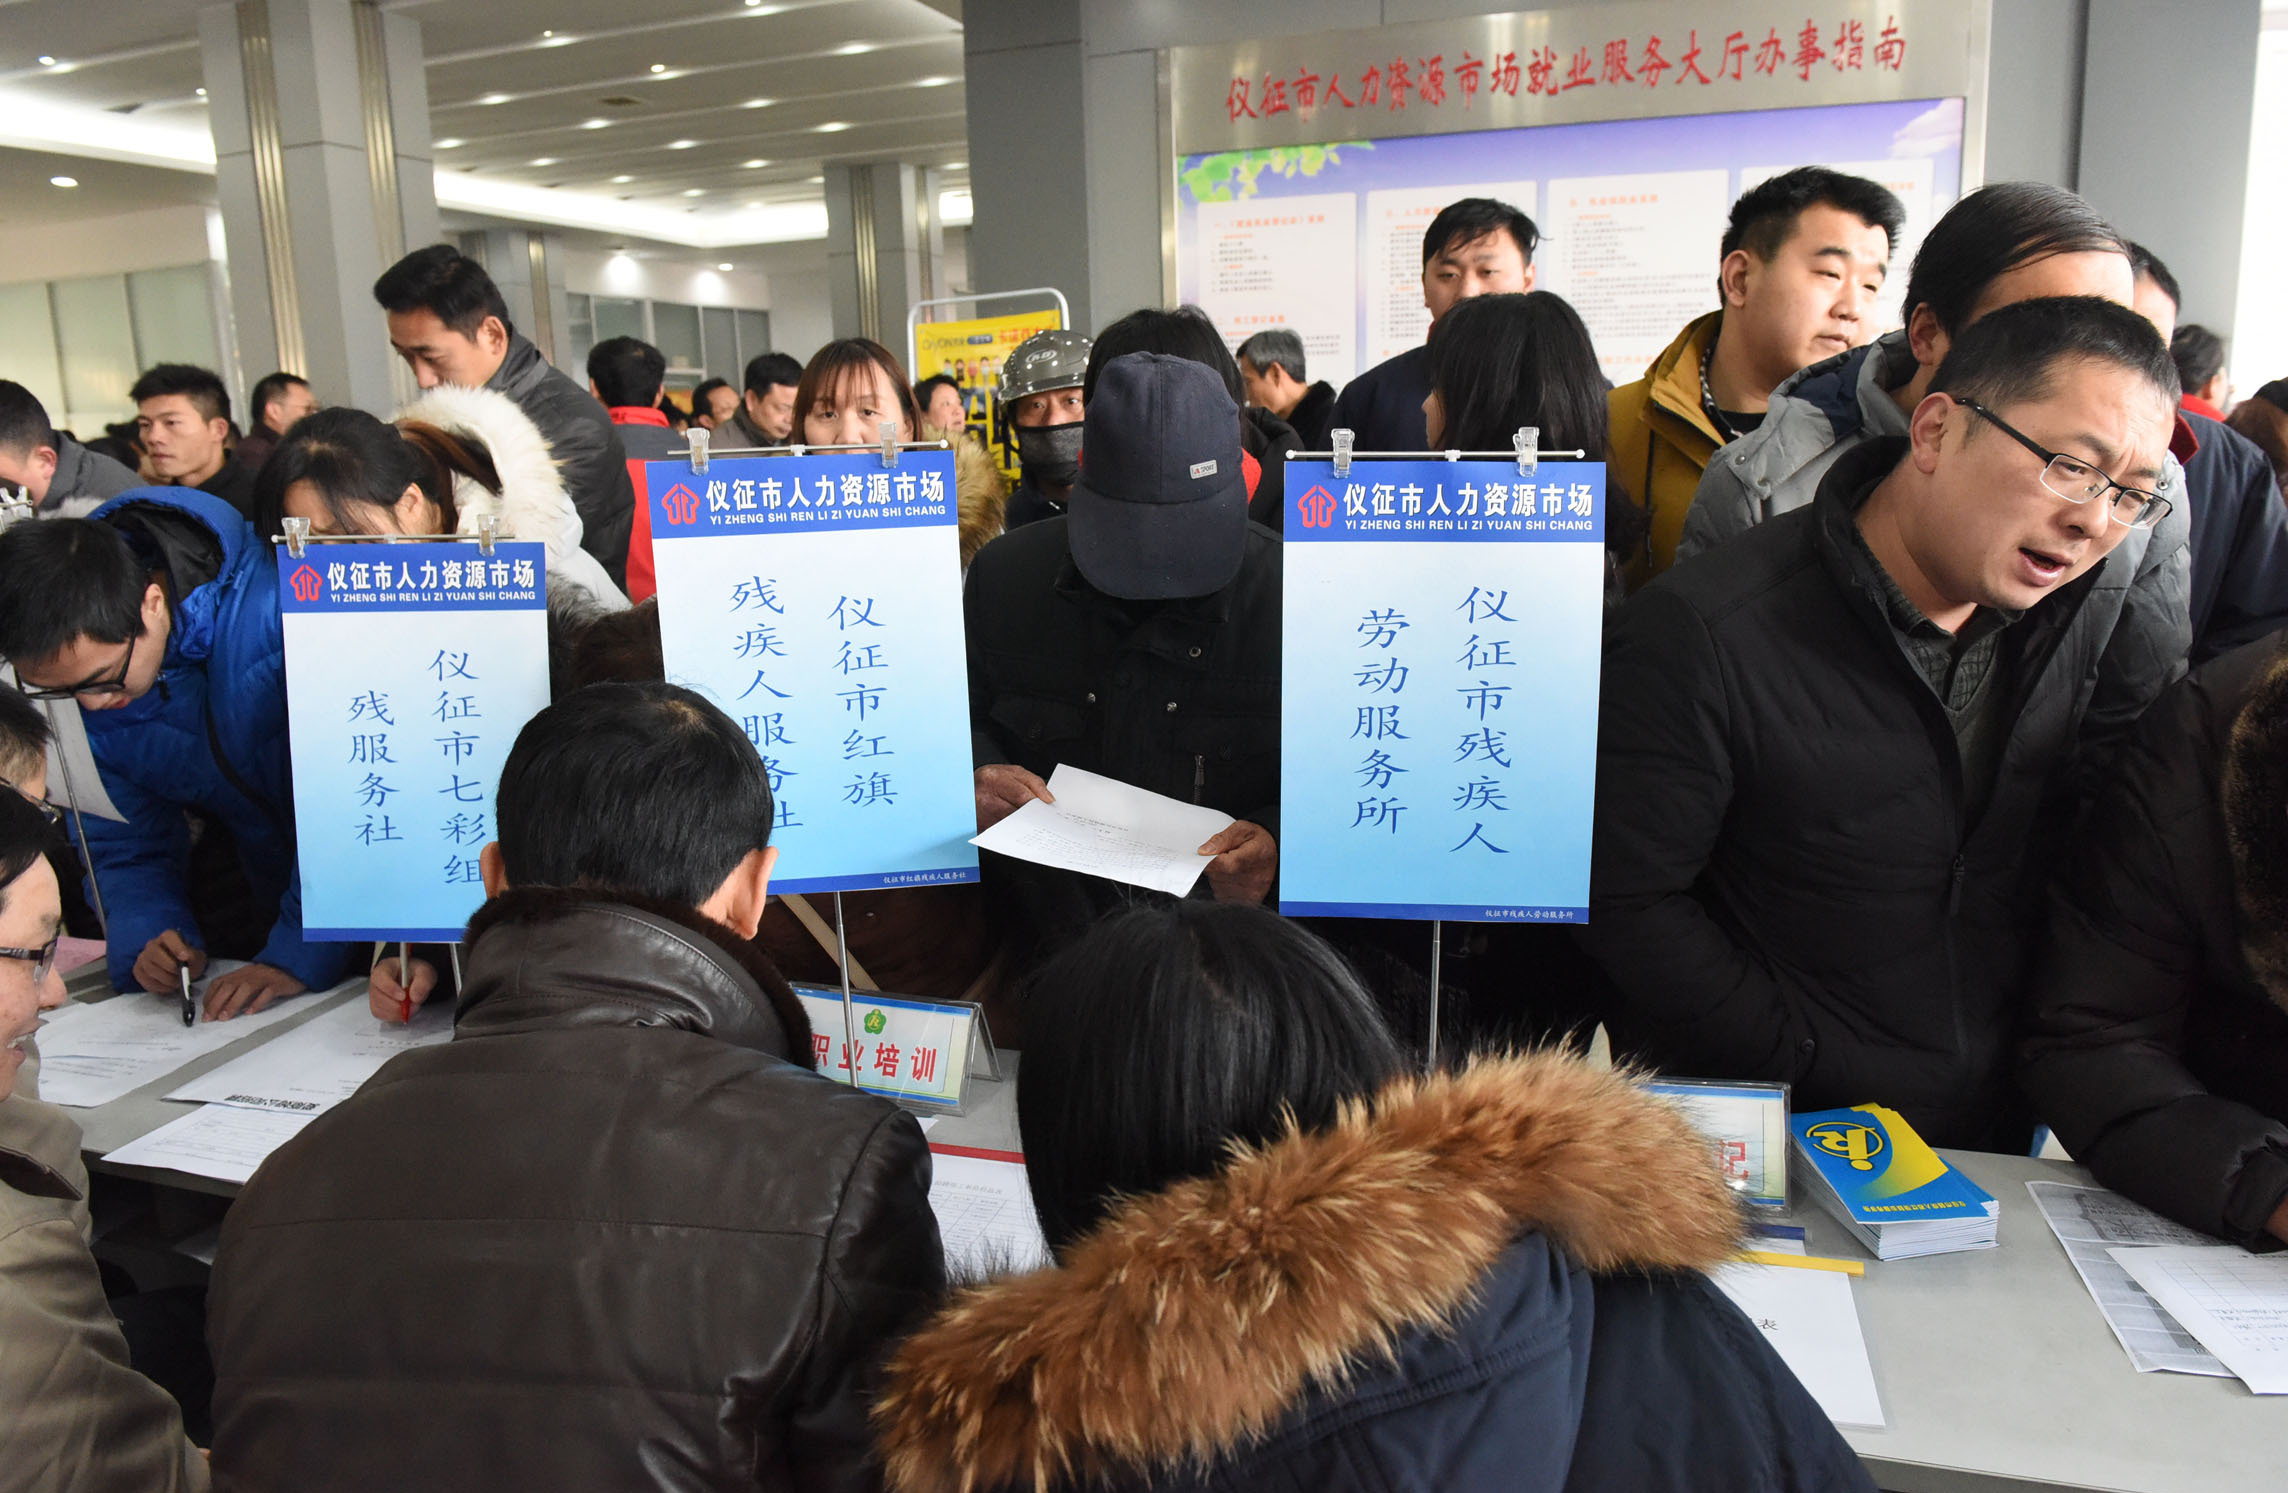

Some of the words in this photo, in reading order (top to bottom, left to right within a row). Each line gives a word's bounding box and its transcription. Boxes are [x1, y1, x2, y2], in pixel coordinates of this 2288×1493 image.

[705, 469, 946, 513] 仪征市人力资源市场
[1343, 481, 1596, 518] 仪征市人力资源市场
[709, 515, 722, 526] YI
[724, 512, 765, 525] ZHENG
[767, 512, 788, 524] SHI
[790, 510, 815, 522] REN
[817, 510, 828, 521] LI
[830, 509, 843, 520] ZI
[844, 506, 879, 520] YUAN
[881, 506, 902, 518] SHI
[904, 504, 946, 517] CHANG
[1344, 519, 1357, 530] YI
[1359, 519, 1401, 530] ZHENG
[1404, 519, 1425, 530] SHI
[1428, 519, 1454, 530] REN
[1457, 520, 1468, 530] LI
[1471, 520, 1483, 531] ZI
[1486, 519, 1522, 531] YUAN
[1525, 519, 1547, 531] SHI
[1549, 519, 1593, 531] CHANG
[326, 558, 536, 592] 仪征市人力资源市场
[330, 593, 341, 603] YI
[343, 592, 377, 603] ZHENG
[379, 592, 397, 603] SHI
[398, 592, 419, 602] REN
[421, 592, 431, 602] LI
[433, 591, 444, 602] ZI
[445, 591, 476, 601] YUAN
[478, 591, 496, 601] SHI
[498, 590, 536, 601] CHANG
[826, 595, 899, 808] 仪征市红旗
[1349, 608, 1412, 836] 劳动服务所
[1449, 586, 1519, 855] 仪征市残疾人
[346, 690, 404, 847] 残服务社
[427, 648, 487, 884] 仪征市七彩组
[1484, 909, 1575, 920] 仪征市残疾人劳动服务所
[811, 1033, 938, 1083] 职业培训
